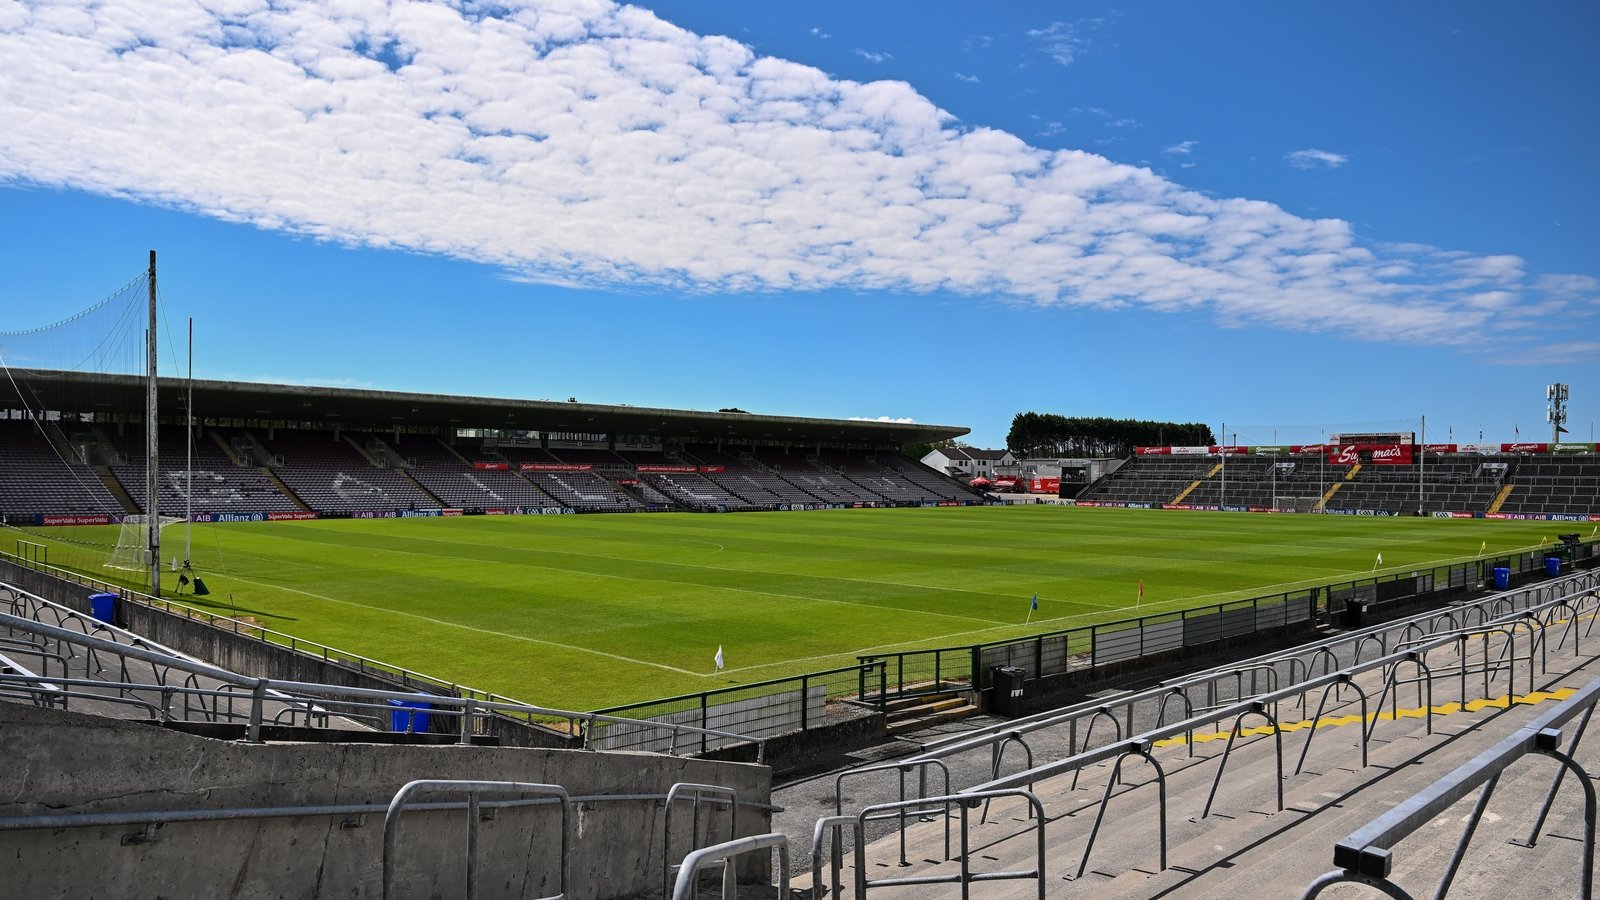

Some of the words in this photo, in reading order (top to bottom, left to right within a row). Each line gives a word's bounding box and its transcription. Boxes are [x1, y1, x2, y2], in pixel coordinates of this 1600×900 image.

[1338, 445, 1401, 464] Sumac's
[44, 517, 76, 525] SuperValu
[77, 516, 108, 524] SuperValu
[196, 513, 212, 522] AIB
[218, 513, 250, 522] Allianz
